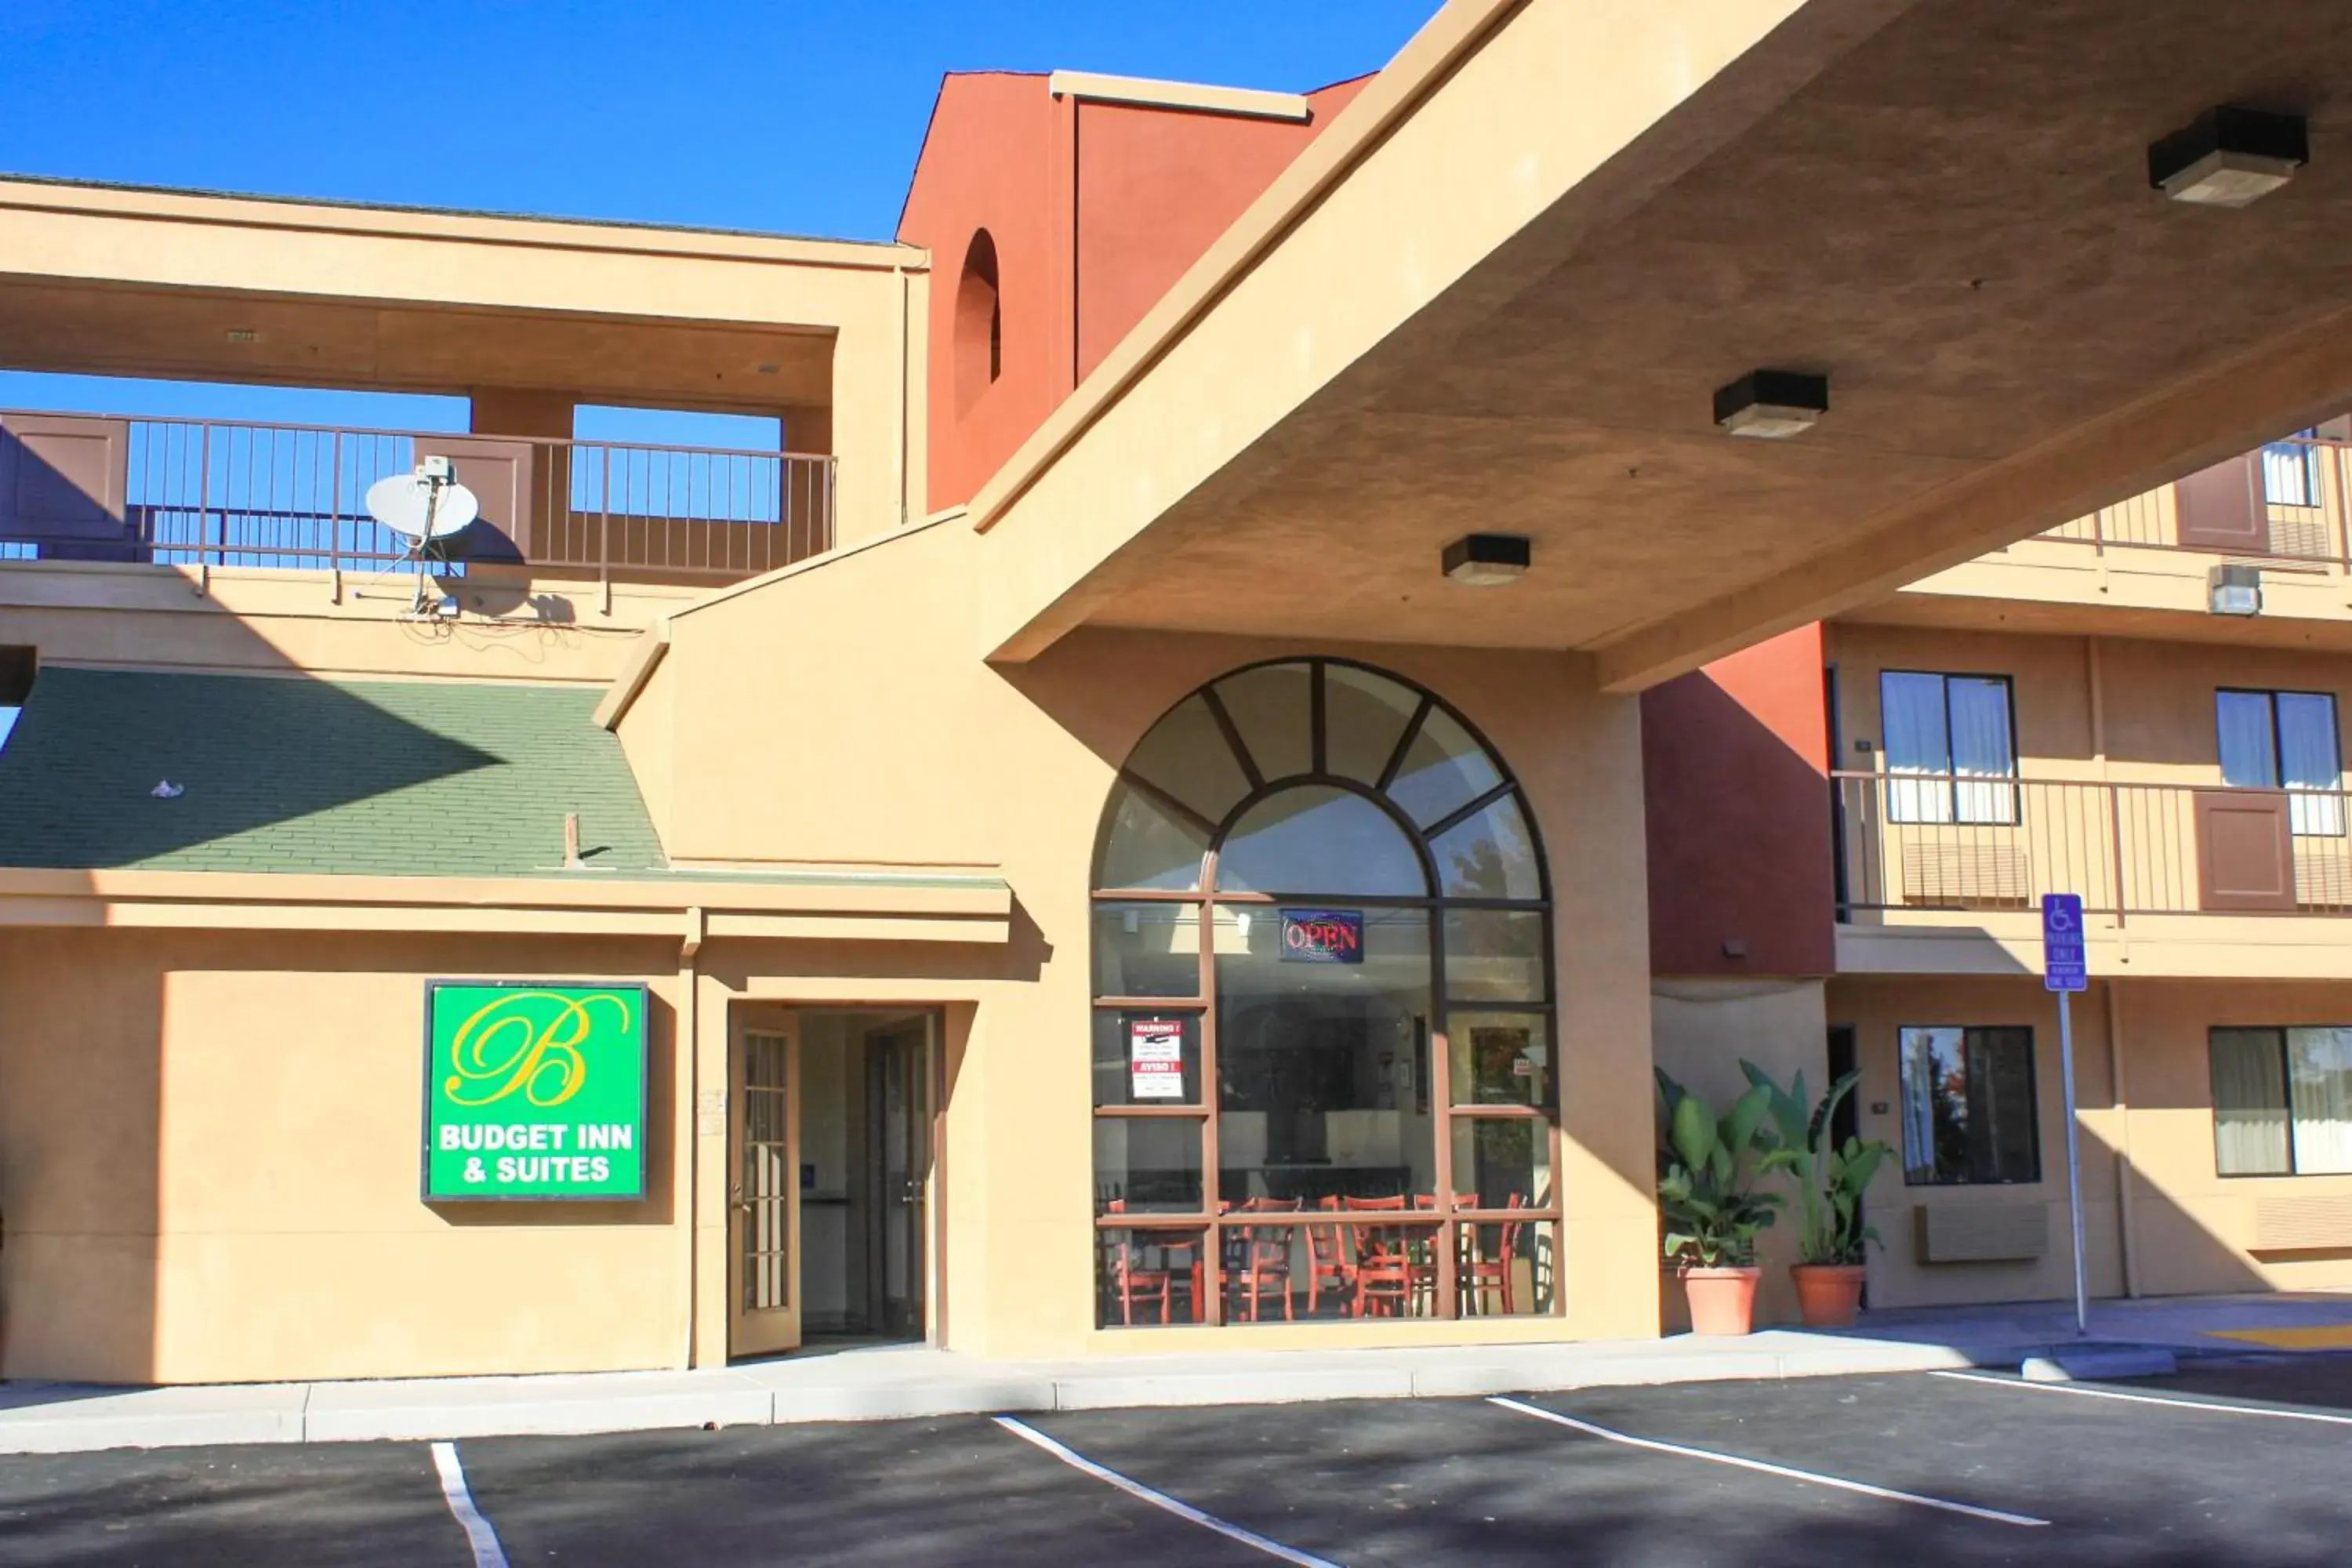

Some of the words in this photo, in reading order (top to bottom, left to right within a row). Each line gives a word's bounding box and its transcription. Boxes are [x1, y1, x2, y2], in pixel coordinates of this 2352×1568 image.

[1287, 924, 1358, 949] OPEN
[445, 992, 629, 1107] B
[439, 1123, 568, 1150] BUDGET
[577, 1123, 632, 1149] INN
[463, 1156, 486, 1182] &
[495, 1156, 610, 1182] SUITES
